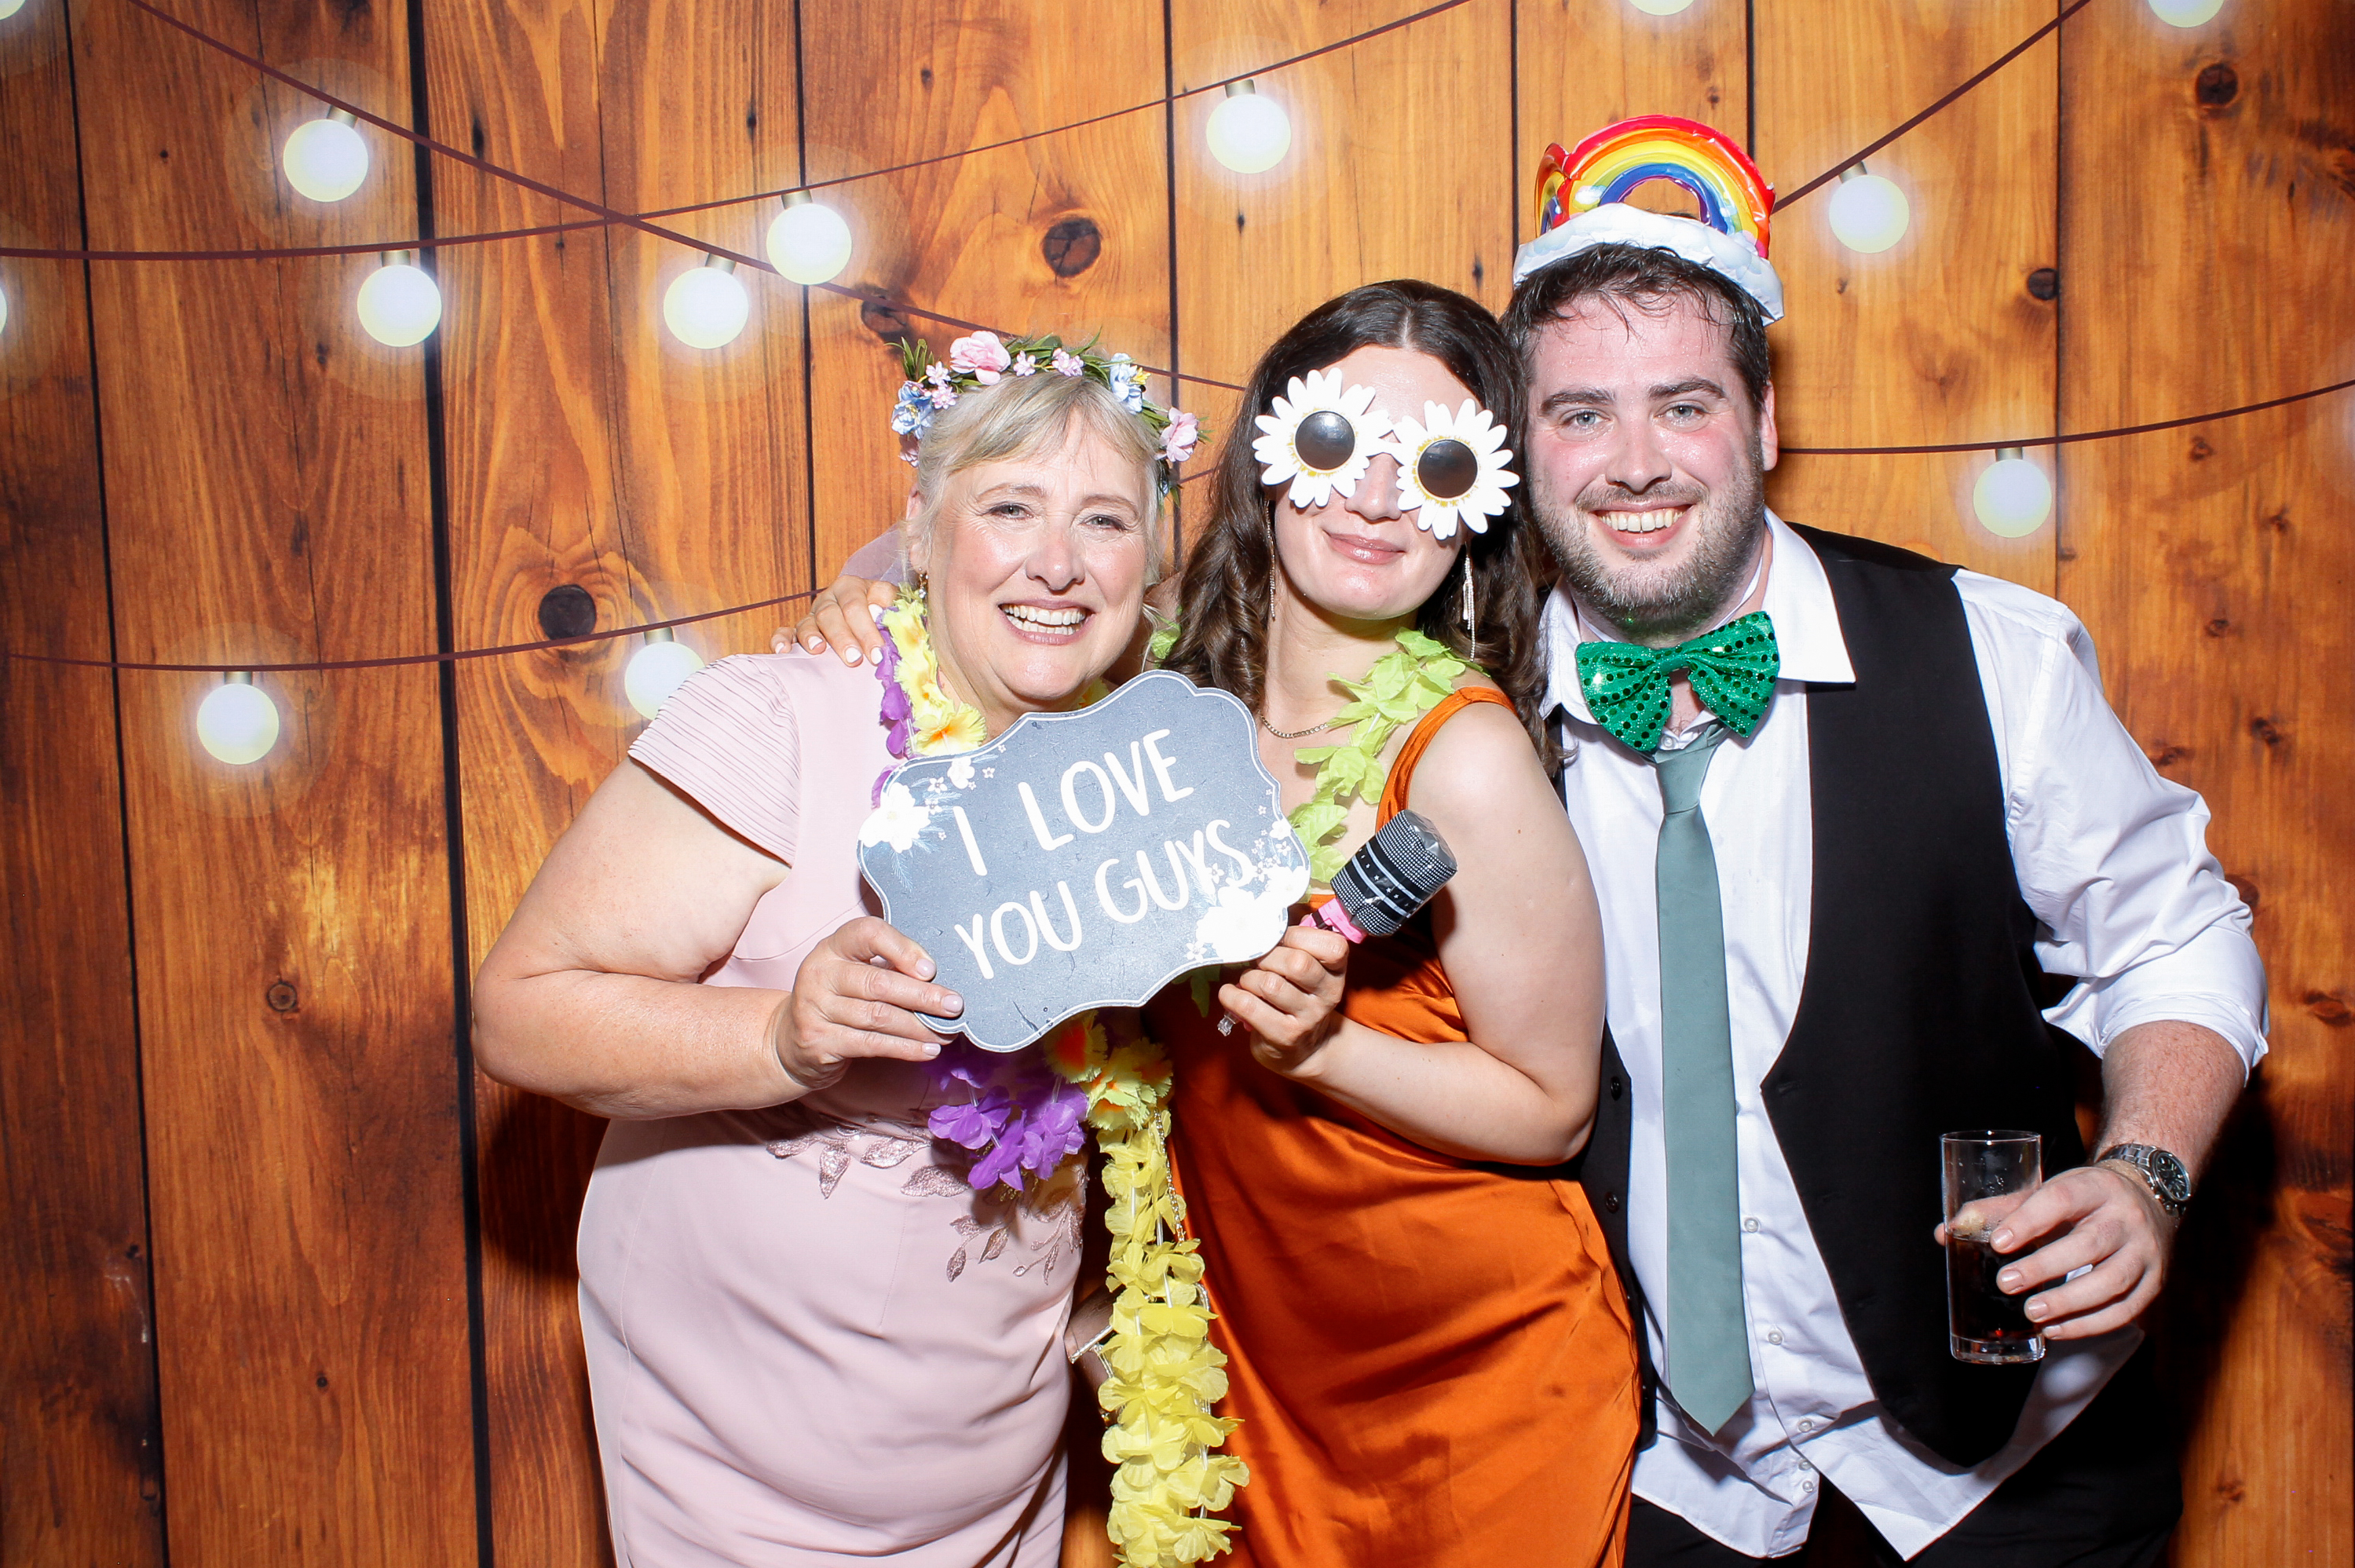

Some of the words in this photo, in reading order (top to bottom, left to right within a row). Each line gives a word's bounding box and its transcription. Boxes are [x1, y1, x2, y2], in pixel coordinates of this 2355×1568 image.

[952, 805, 988, 876] I
[1018, 729, 1194, 851] LOVE
[954, 880, 1083, 979] YOU
[1095, 820, 1255, 923] GUYS
